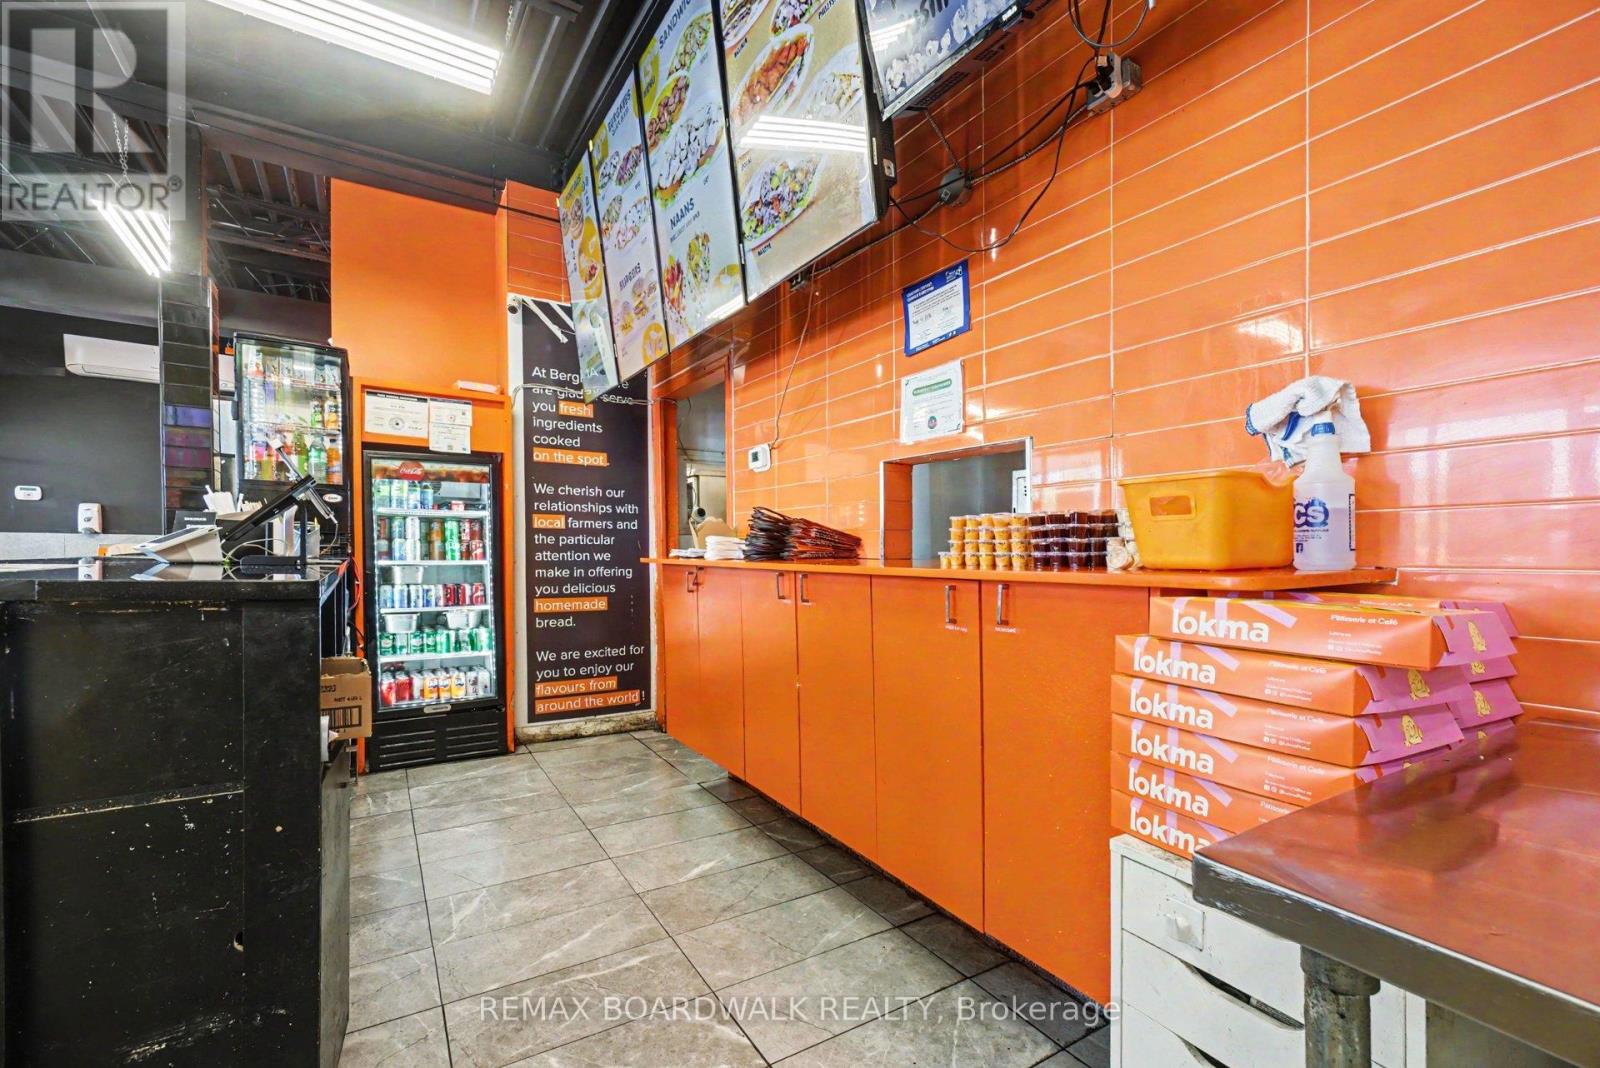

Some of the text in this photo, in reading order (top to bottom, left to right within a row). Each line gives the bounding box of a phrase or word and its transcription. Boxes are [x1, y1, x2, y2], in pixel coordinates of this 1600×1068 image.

[670, 197, 695, 230] NAANS
[532, 366, 580, 385] At Berg
[532, 401, 592, 417] you fresh
[533, 416, 603, 433] ingredients
[533, 434, 581, 448] cooked
[533, 452, 550, 462] on
[553, 452, 574, 464] the
[534, 483, 625, 498] We cherish our
[534, 500, 639, 515] relationships with
[534, 517, 638, 530] local farmers and
[534, 533, 615, 547] the particular
[535, 550, 611, 561] attention we
[535, 565, 633, 579] make in offering
[534, 582, 616, 596] you delicious
[535, 598, 606, 611] homemade
[535, 616, 577, 629] bread.
[1172, 605, 1269, 643] lokma
[536, 643, 645, 662] We are excited for
[536, 661, 635, 682] you to enjoy our
[1133, 646, 1217, 685] lokma
[535, 676, 617, 696] flavours from
[535, 697, 582, 714] around
[584, 695, 604, 708] the
[1129, 687, 1214, 730] lokma
[1130, 728, 1214, 775] lokma
[1128, 766, 1209, 817] lokma
